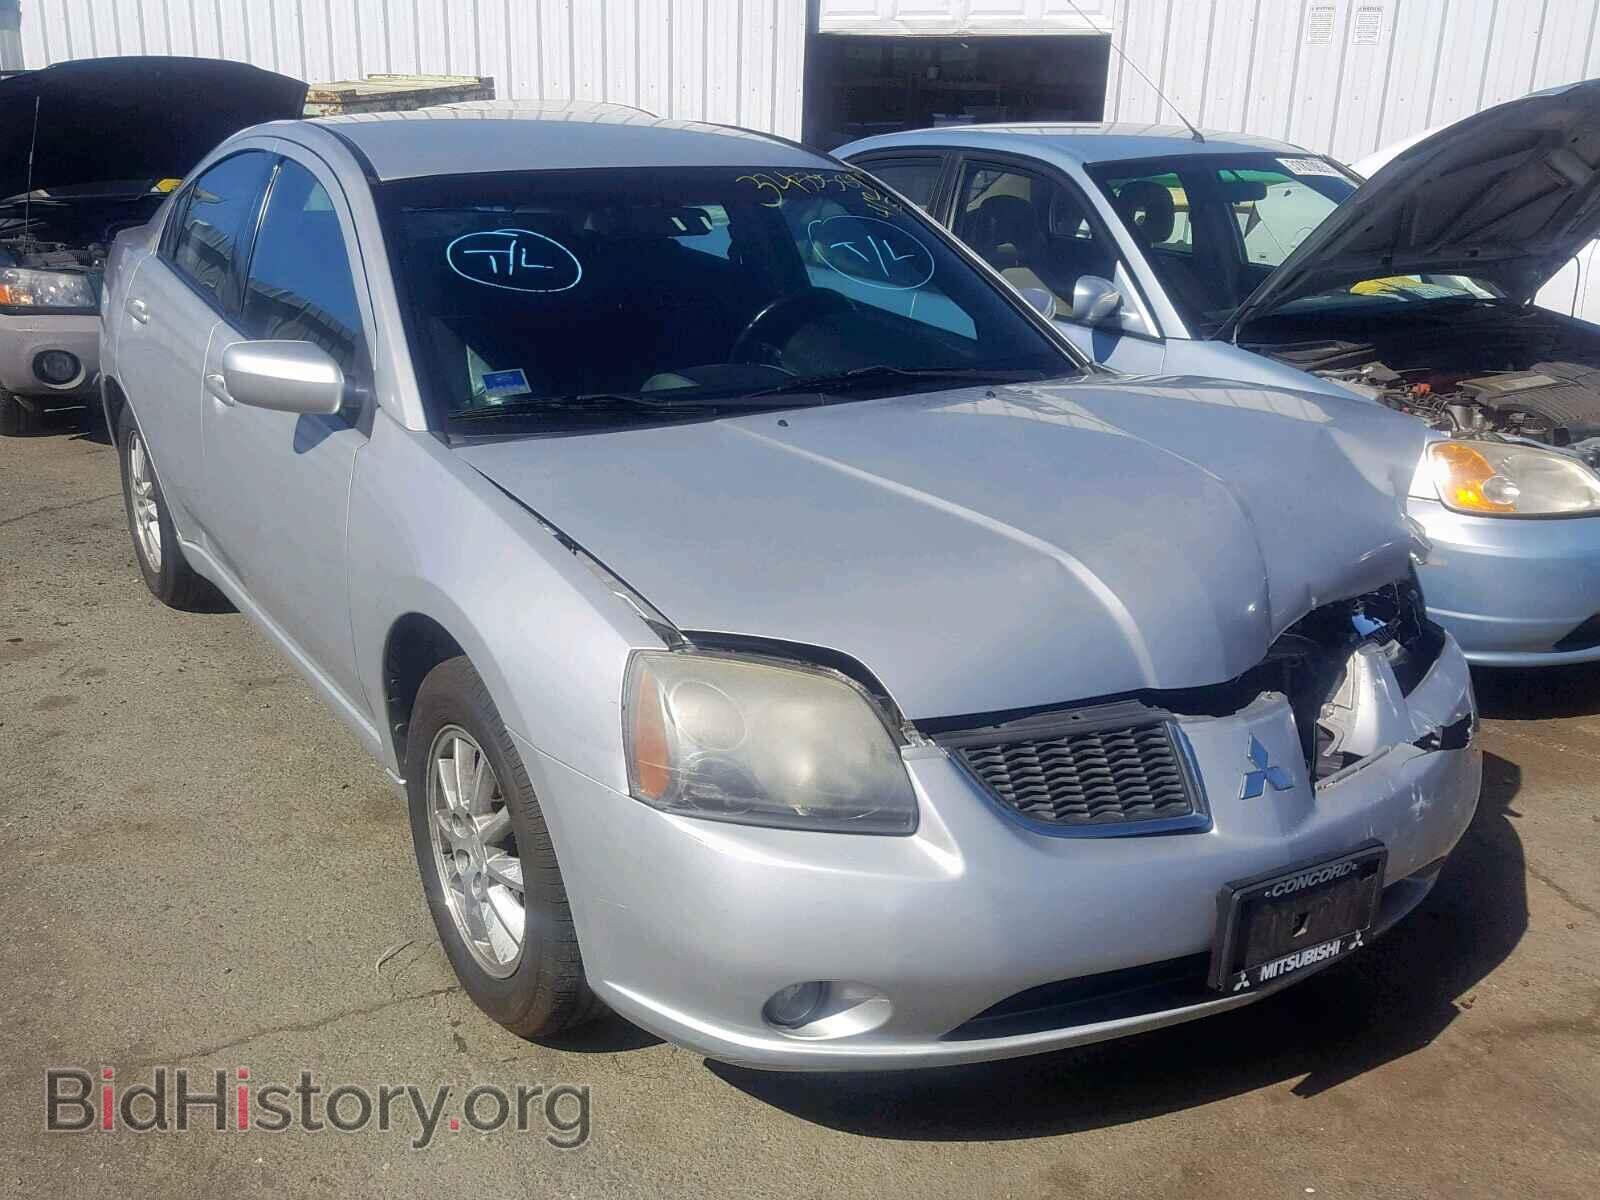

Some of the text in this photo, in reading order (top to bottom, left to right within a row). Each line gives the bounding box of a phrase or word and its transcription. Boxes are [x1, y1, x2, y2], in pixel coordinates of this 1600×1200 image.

[464, 239, 555, 276] T/L
[830, 235, 916, 278] T/L
[1271, 863, 1353, 897] CONCORD
[1259, 939, 1341, 982] MITSUBISHI
